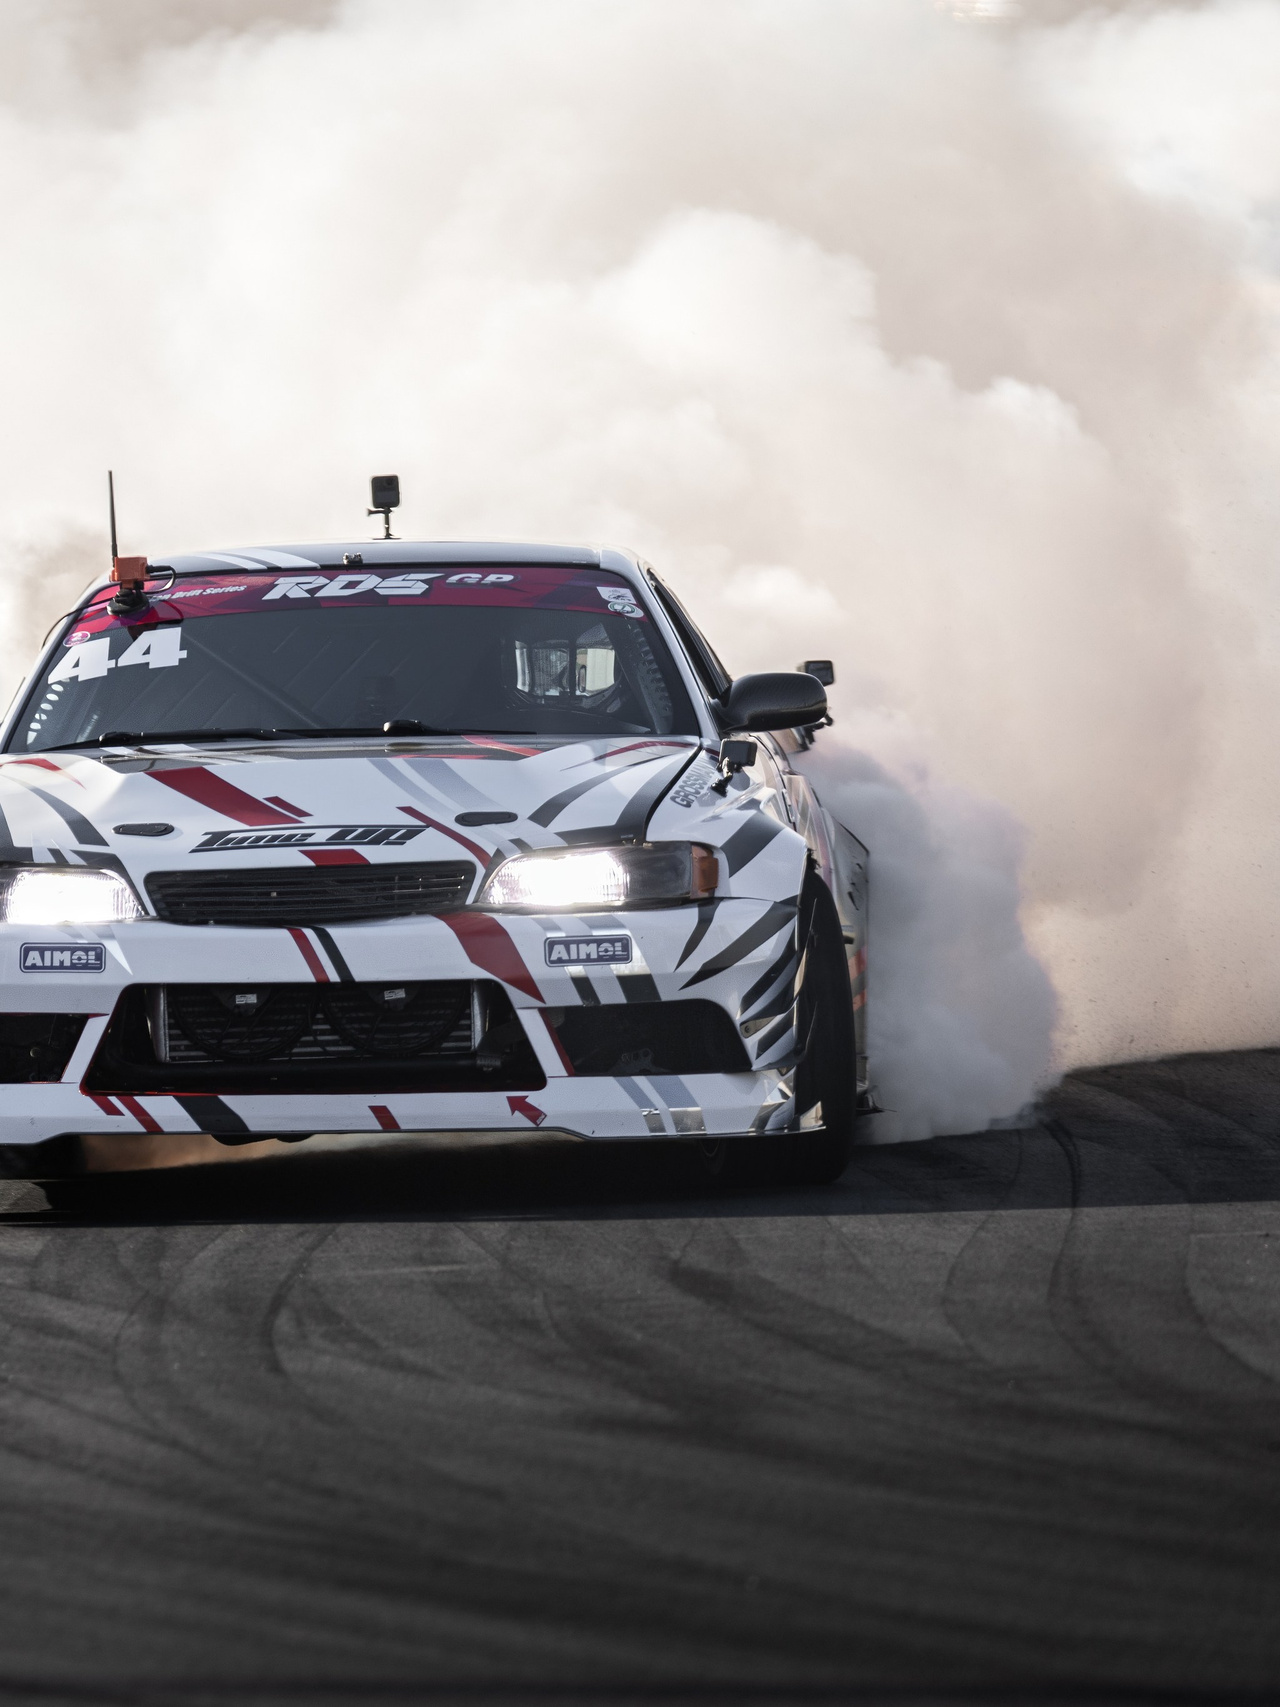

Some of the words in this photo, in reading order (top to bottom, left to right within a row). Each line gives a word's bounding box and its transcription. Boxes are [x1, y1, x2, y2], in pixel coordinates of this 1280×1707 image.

[171, 589, 203, 599] Drift
[202, 585, 247, 595] Series
[262, 573, 445, 600] RDS
[47, 626, 188, 685] 44
[24, 950, 101, 967] AIMOL
[549, 942, 628, 960] AIMOL
